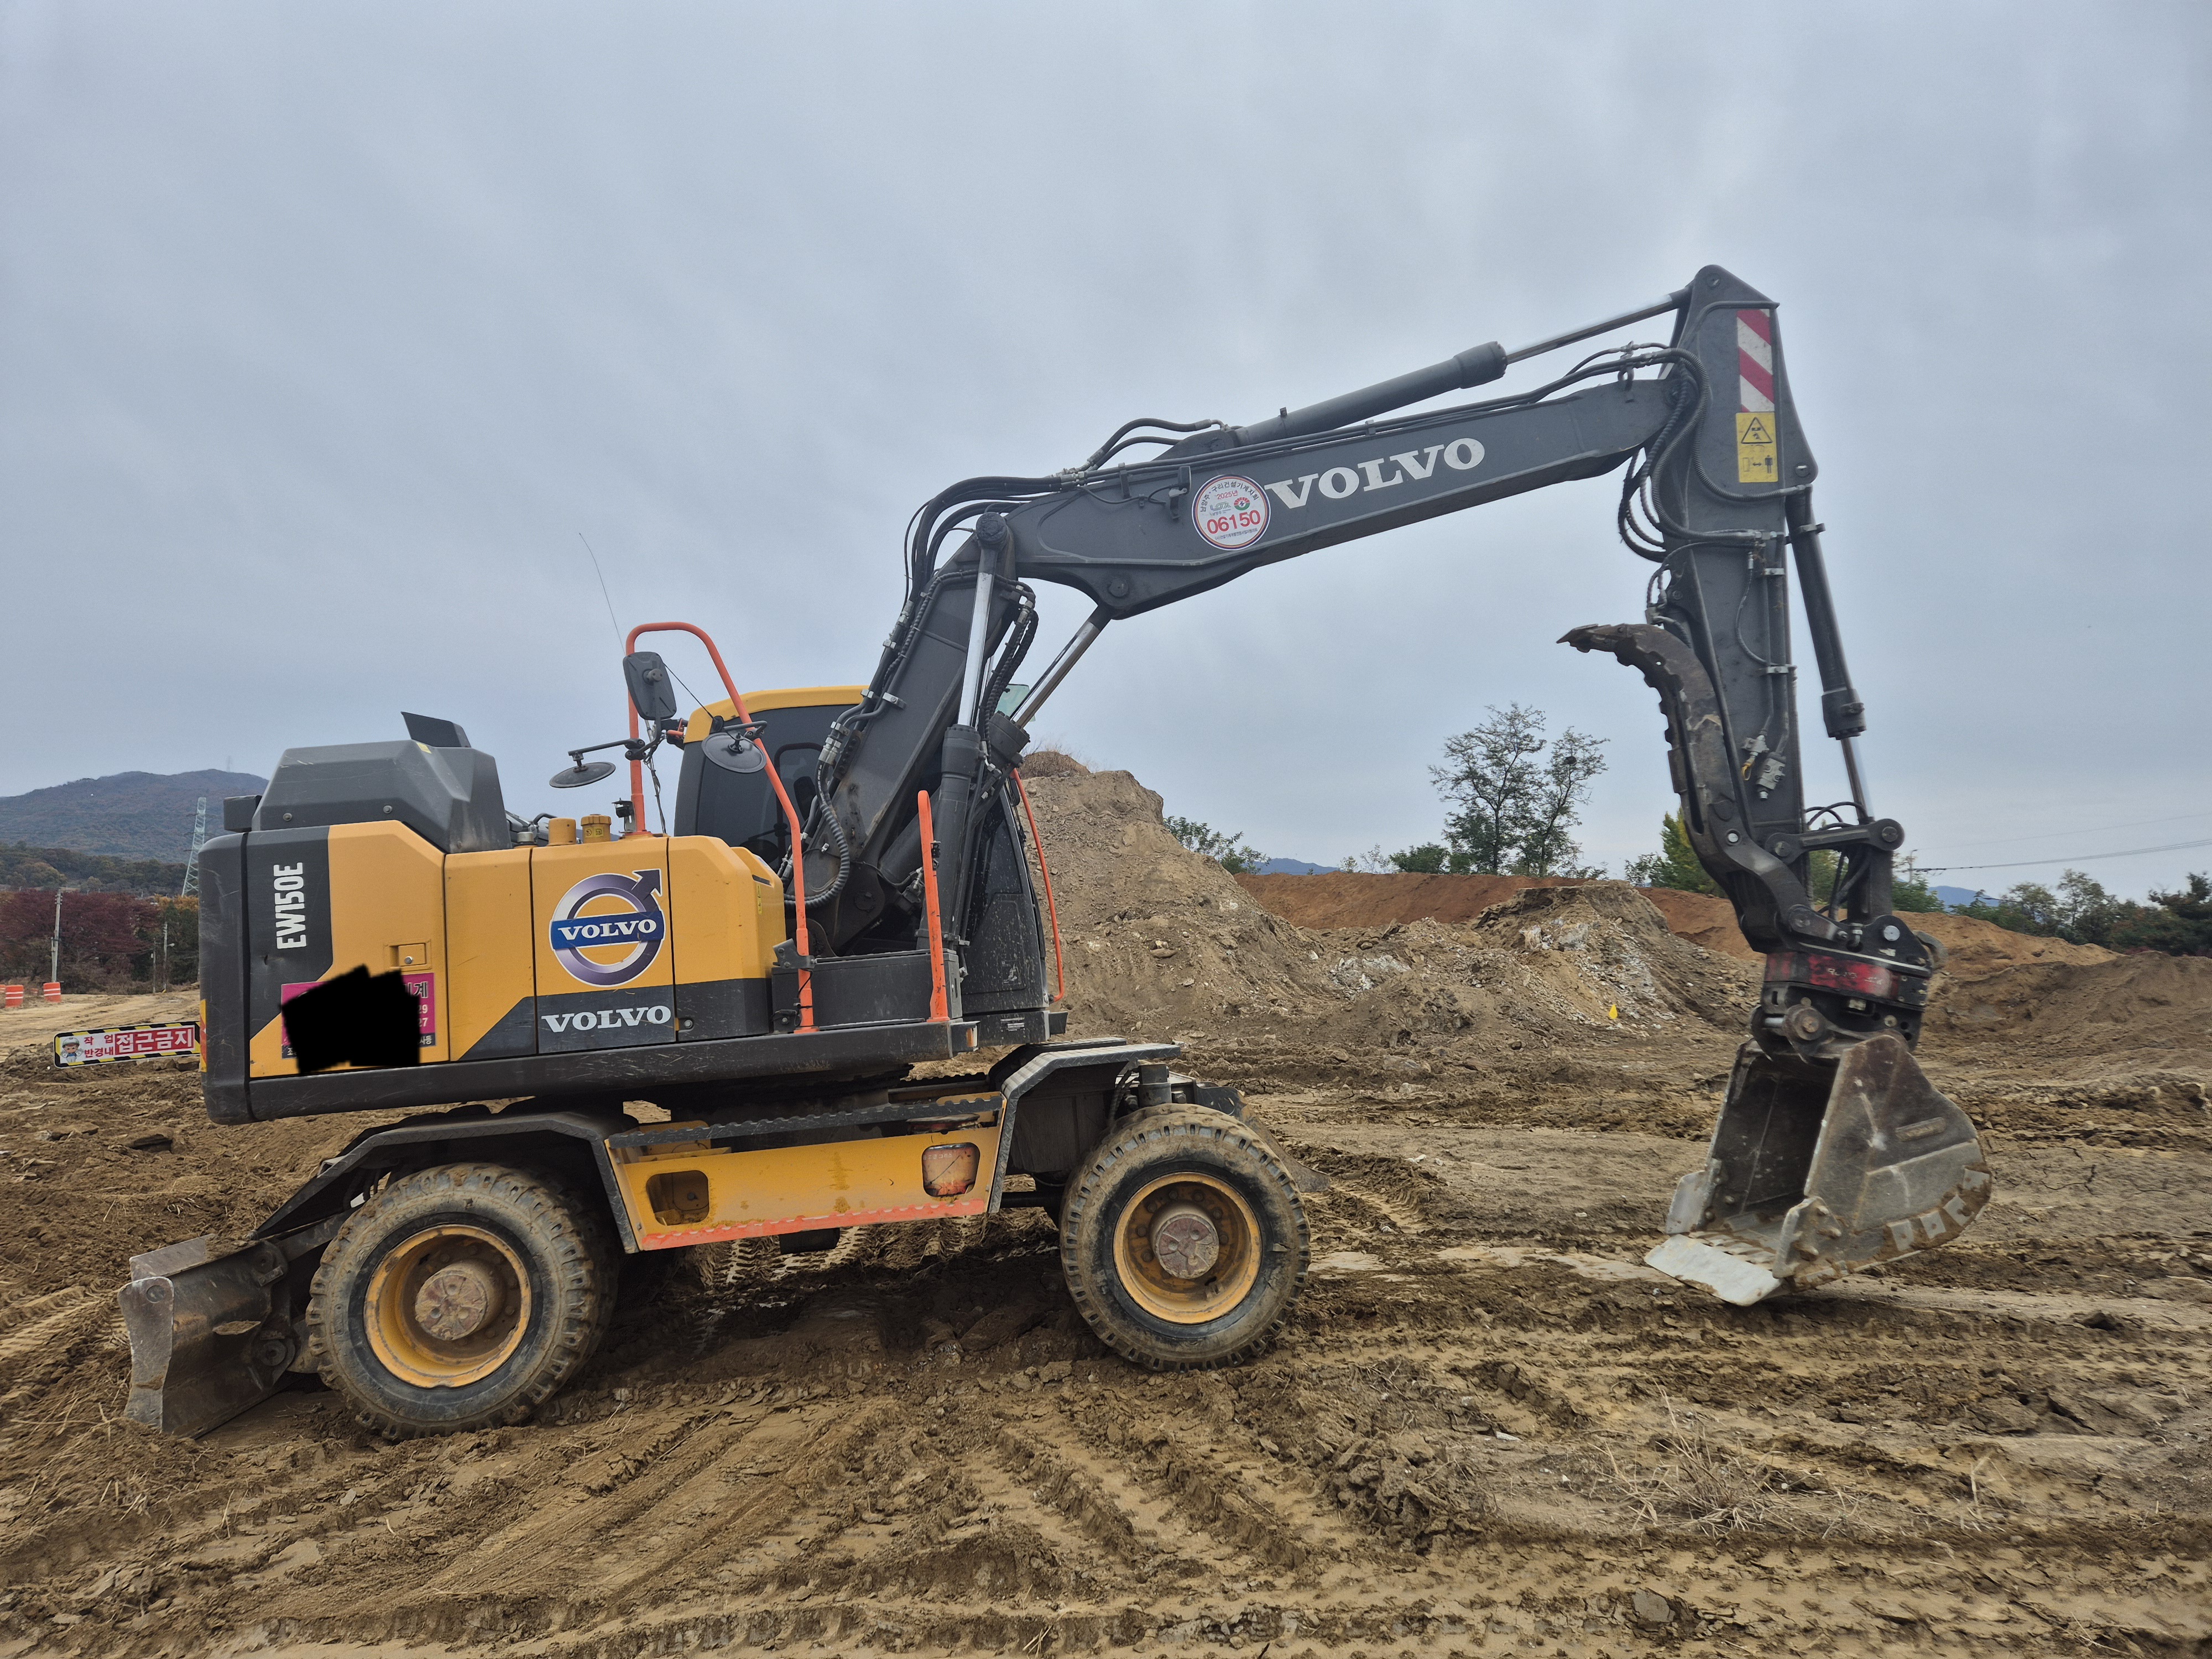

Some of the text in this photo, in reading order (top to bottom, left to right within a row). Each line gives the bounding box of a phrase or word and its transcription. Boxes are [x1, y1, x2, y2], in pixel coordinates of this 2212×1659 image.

[1264, 437, 1485, 509] VOLVO
[1217, 490, 1238, 500] 2025년
[1207, 510, 1261, 534] 06150
[273, 862, 307, 949] EW150E
[557, 919, 657, 940] VOLVO
[541, 1005, 671, 1032] VOLVO
[84, 1046, 114, 1058] 반경내
[117, 1029, 192, 1053] 접근금지
